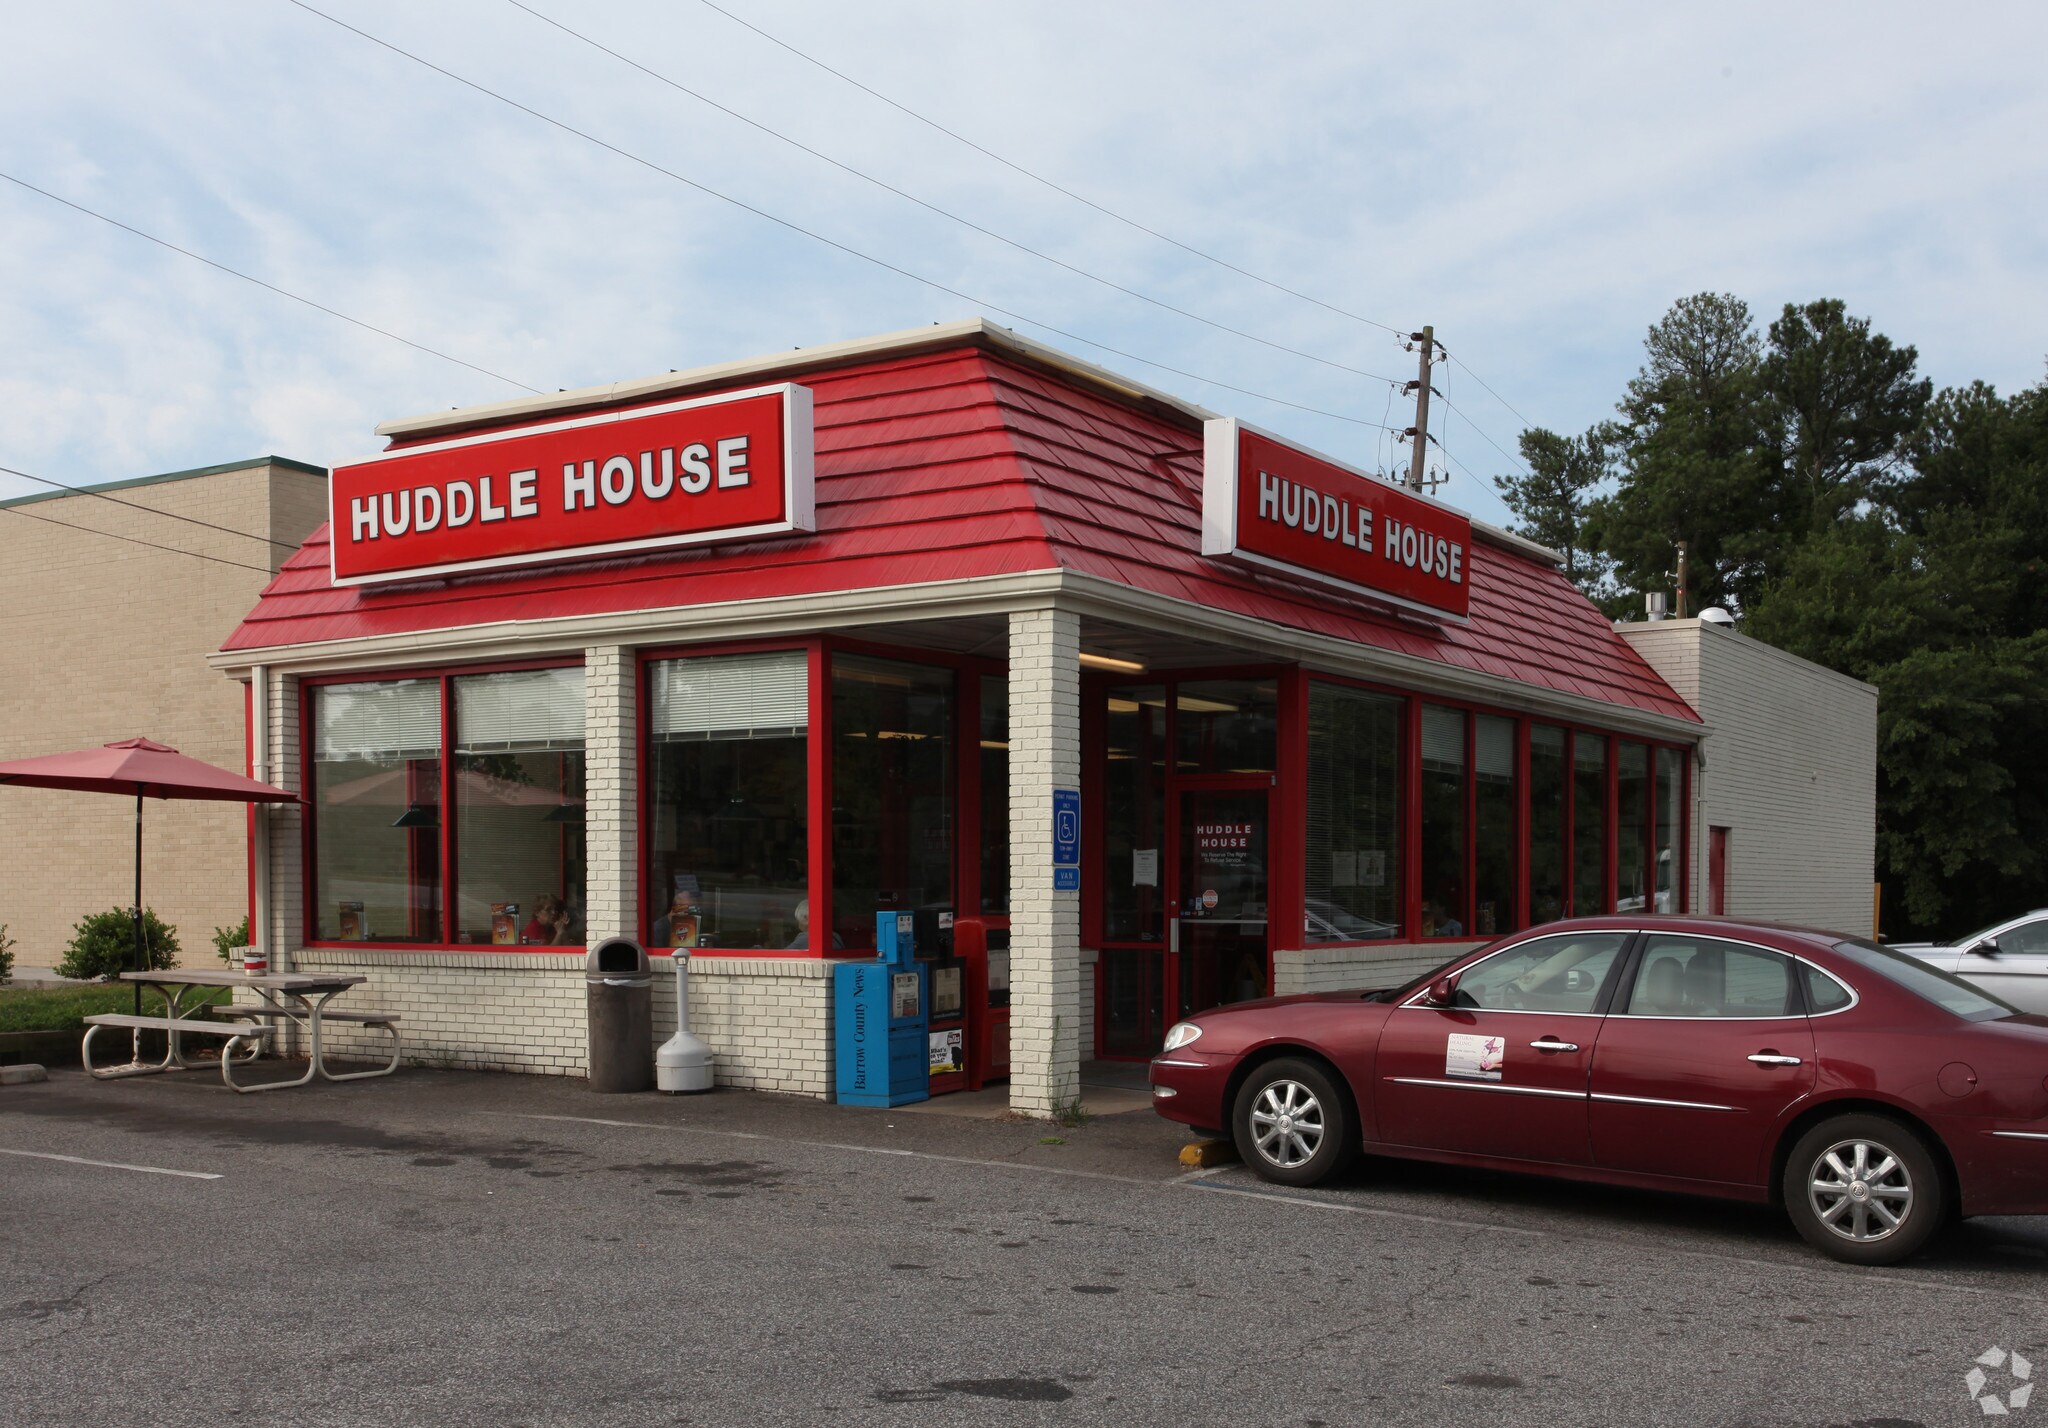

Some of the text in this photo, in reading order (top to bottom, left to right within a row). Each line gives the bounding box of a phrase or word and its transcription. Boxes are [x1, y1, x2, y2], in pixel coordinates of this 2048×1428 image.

[350, 435, 750, 543] HUDDLE HOUSE
[1258, 471, 1463, 585] HUDDLE HOUSE
[1197, 825, 1252, 834] HUDDLE
[1201, 838, 1247, 847] HOUSE
[1060, 872, 1073, 880] VAN
[853, 968, 868, 1091] Barrow County News
